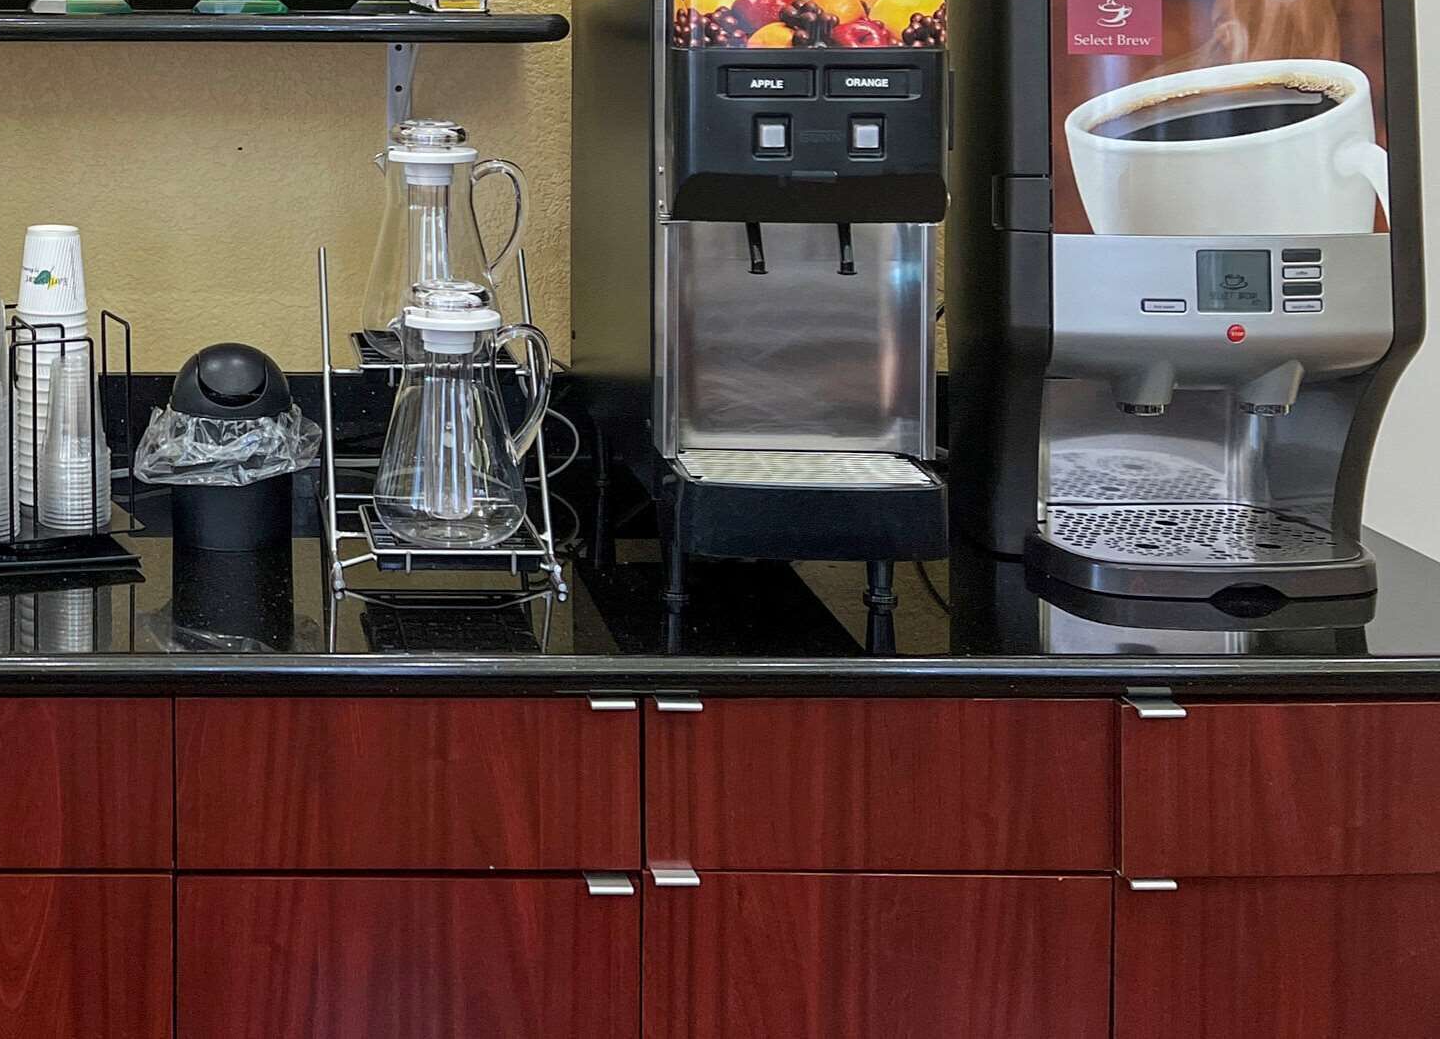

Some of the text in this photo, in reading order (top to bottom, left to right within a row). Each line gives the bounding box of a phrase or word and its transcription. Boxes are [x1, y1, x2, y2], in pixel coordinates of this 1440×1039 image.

[1073, 33, 1151, 45] Select Brew
[750, 79, 784, 89] APPLE
[845, 77, 889, 88] ORANGE
